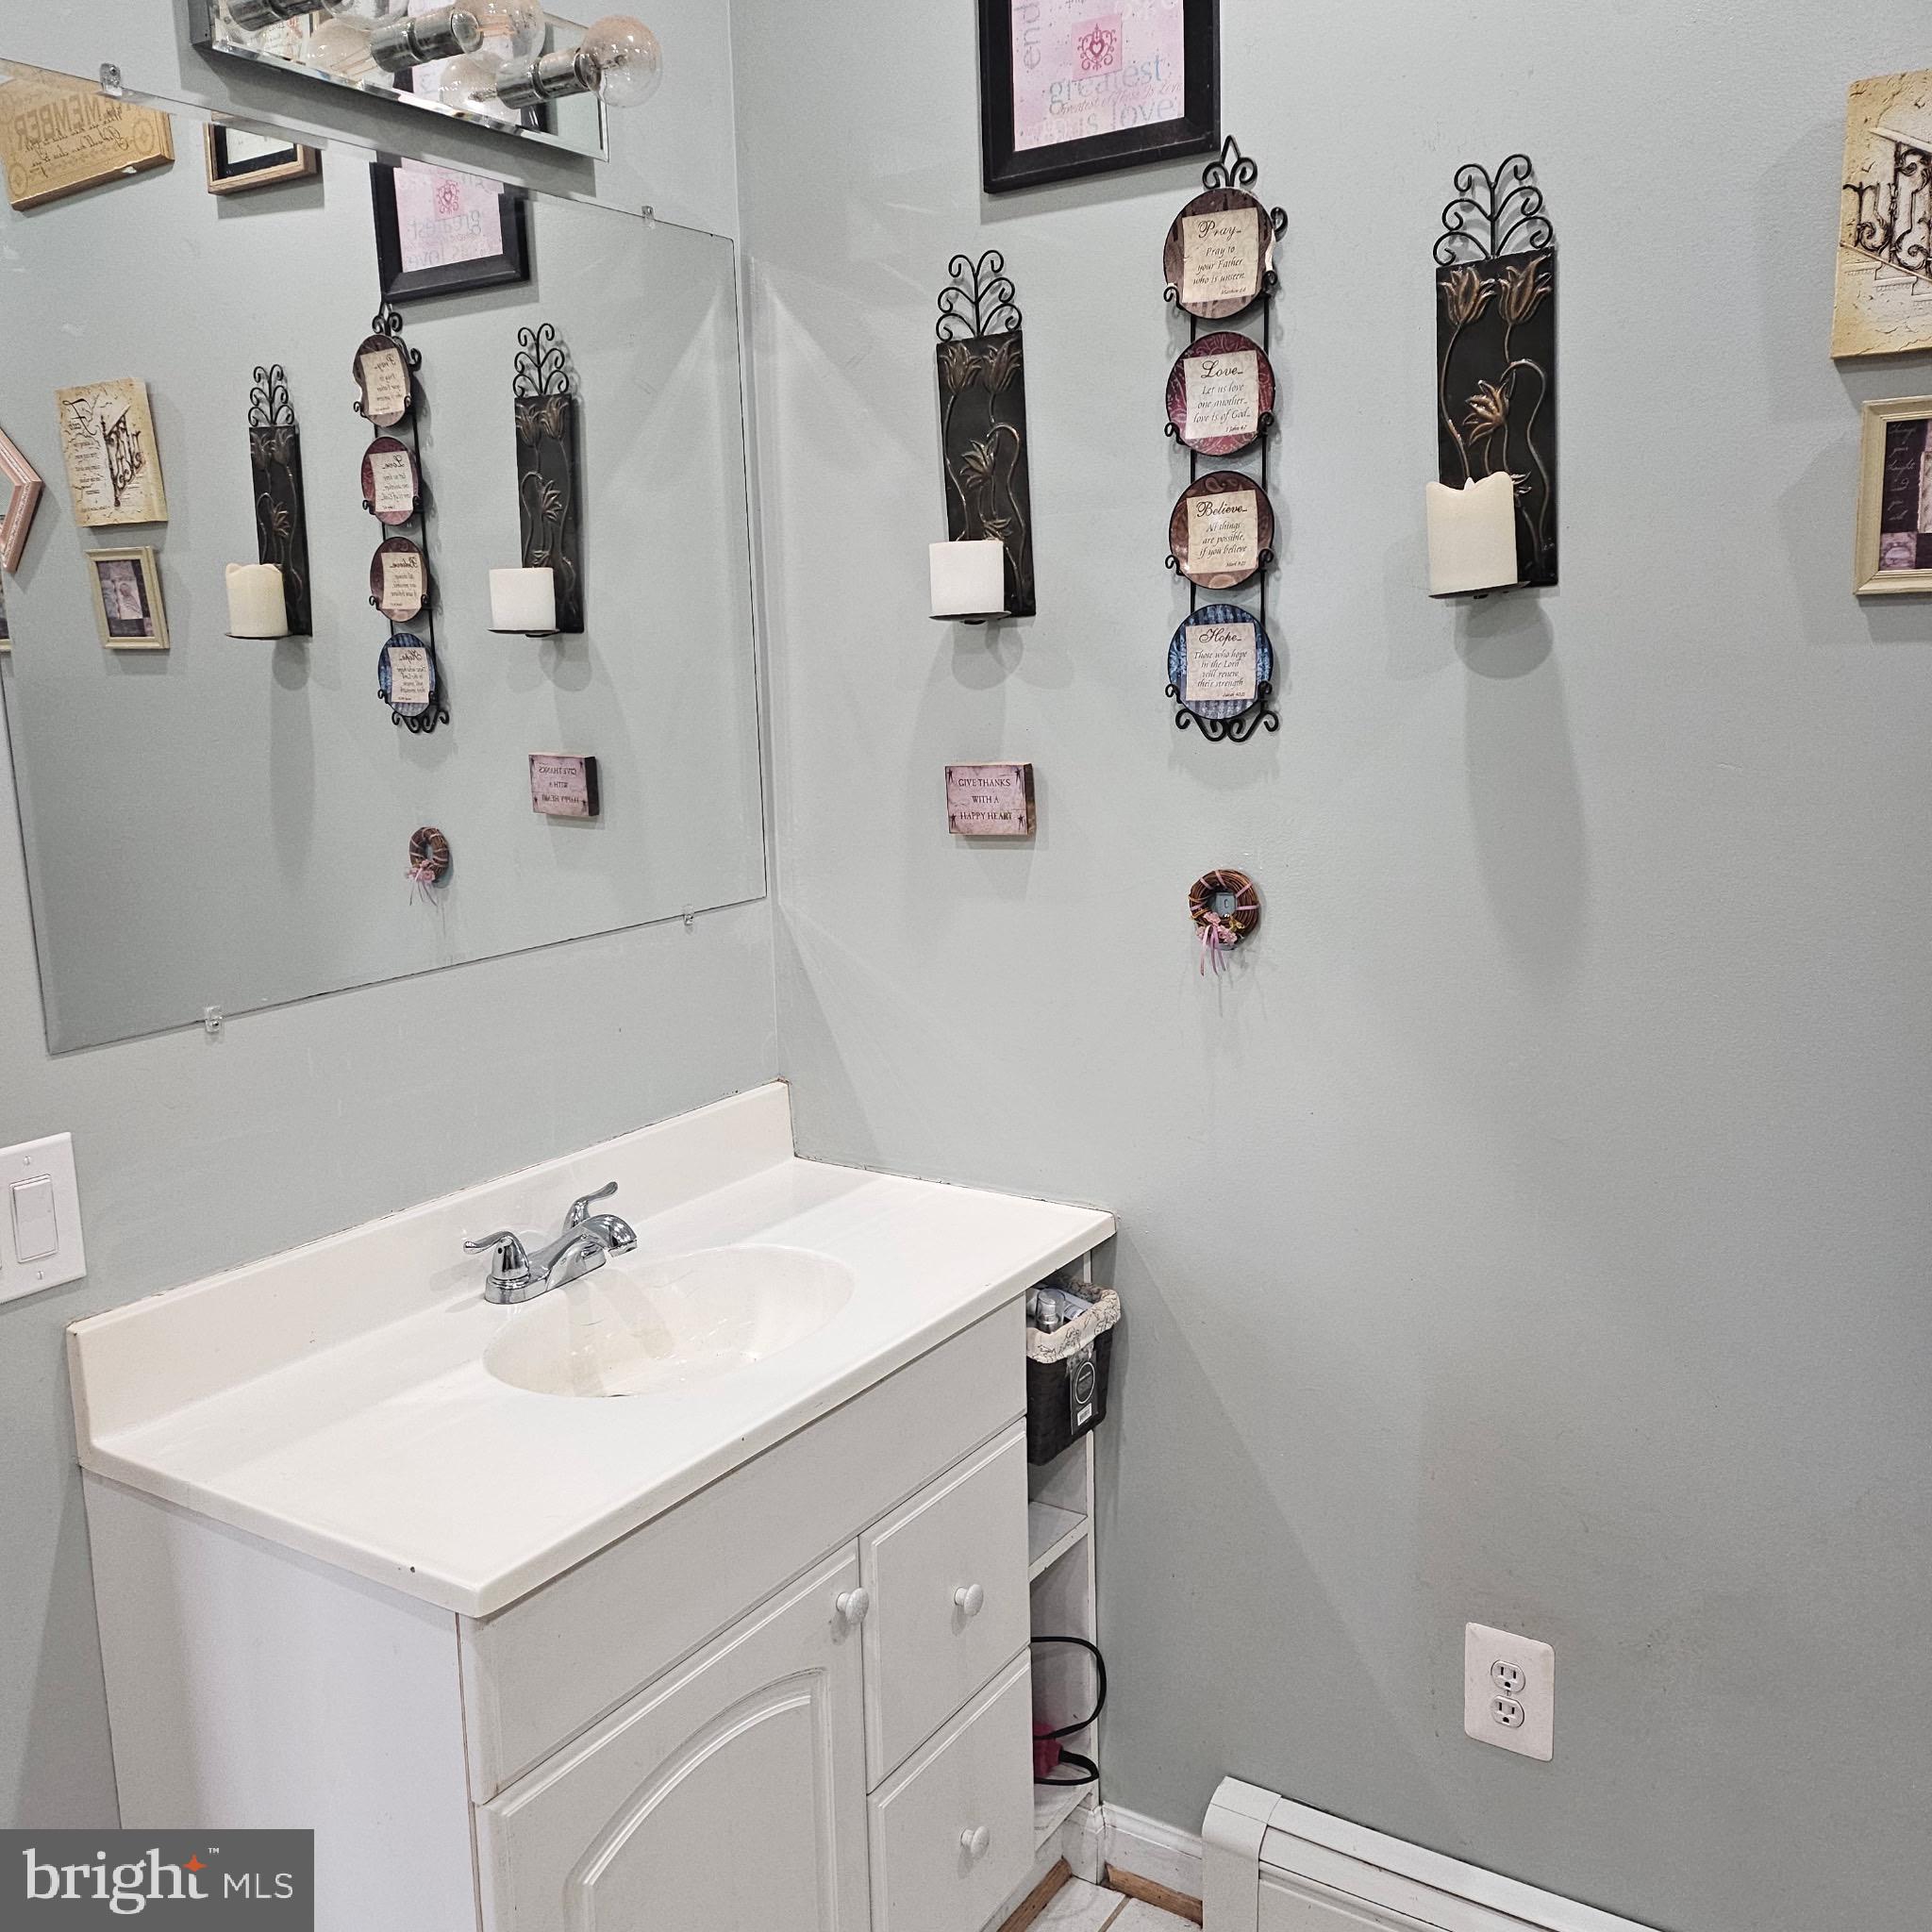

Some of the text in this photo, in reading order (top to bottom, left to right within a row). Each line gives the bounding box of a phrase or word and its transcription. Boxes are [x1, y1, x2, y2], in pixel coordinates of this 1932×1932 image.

[1048, 54, 1162, 116] greatest
[1110, 97, 1174, 131] love
[1218, 257, 1244, 270] Father
[1193, 275, 1209, 285] who
[1202, 386, 1215, 395] Let
[1227, 380, 1244, 392] love
[1197, 400, 1212, 409] one
[1192, 411, 1209, 424] love
[1211, 412, 1218, 422] is
[1220, 408, 1232, 425] of
[1197, 547, 1207, 559] if
[1208, 548, 1222, 559] you
[1193, 649, 1248, 663] Those who hope
[1210, 659, 1222, 668] the
[1224, 659, 1241, 668] Lord
[1202, 668, 1216, 677] will
[1197, 677, 1244, 690] their strength
[958, 778, 1011, 787] GIVE THANKS
[972, 795, 1000, 804] WITH A
[960, 811, 1013, 821] HAPPY HEART
